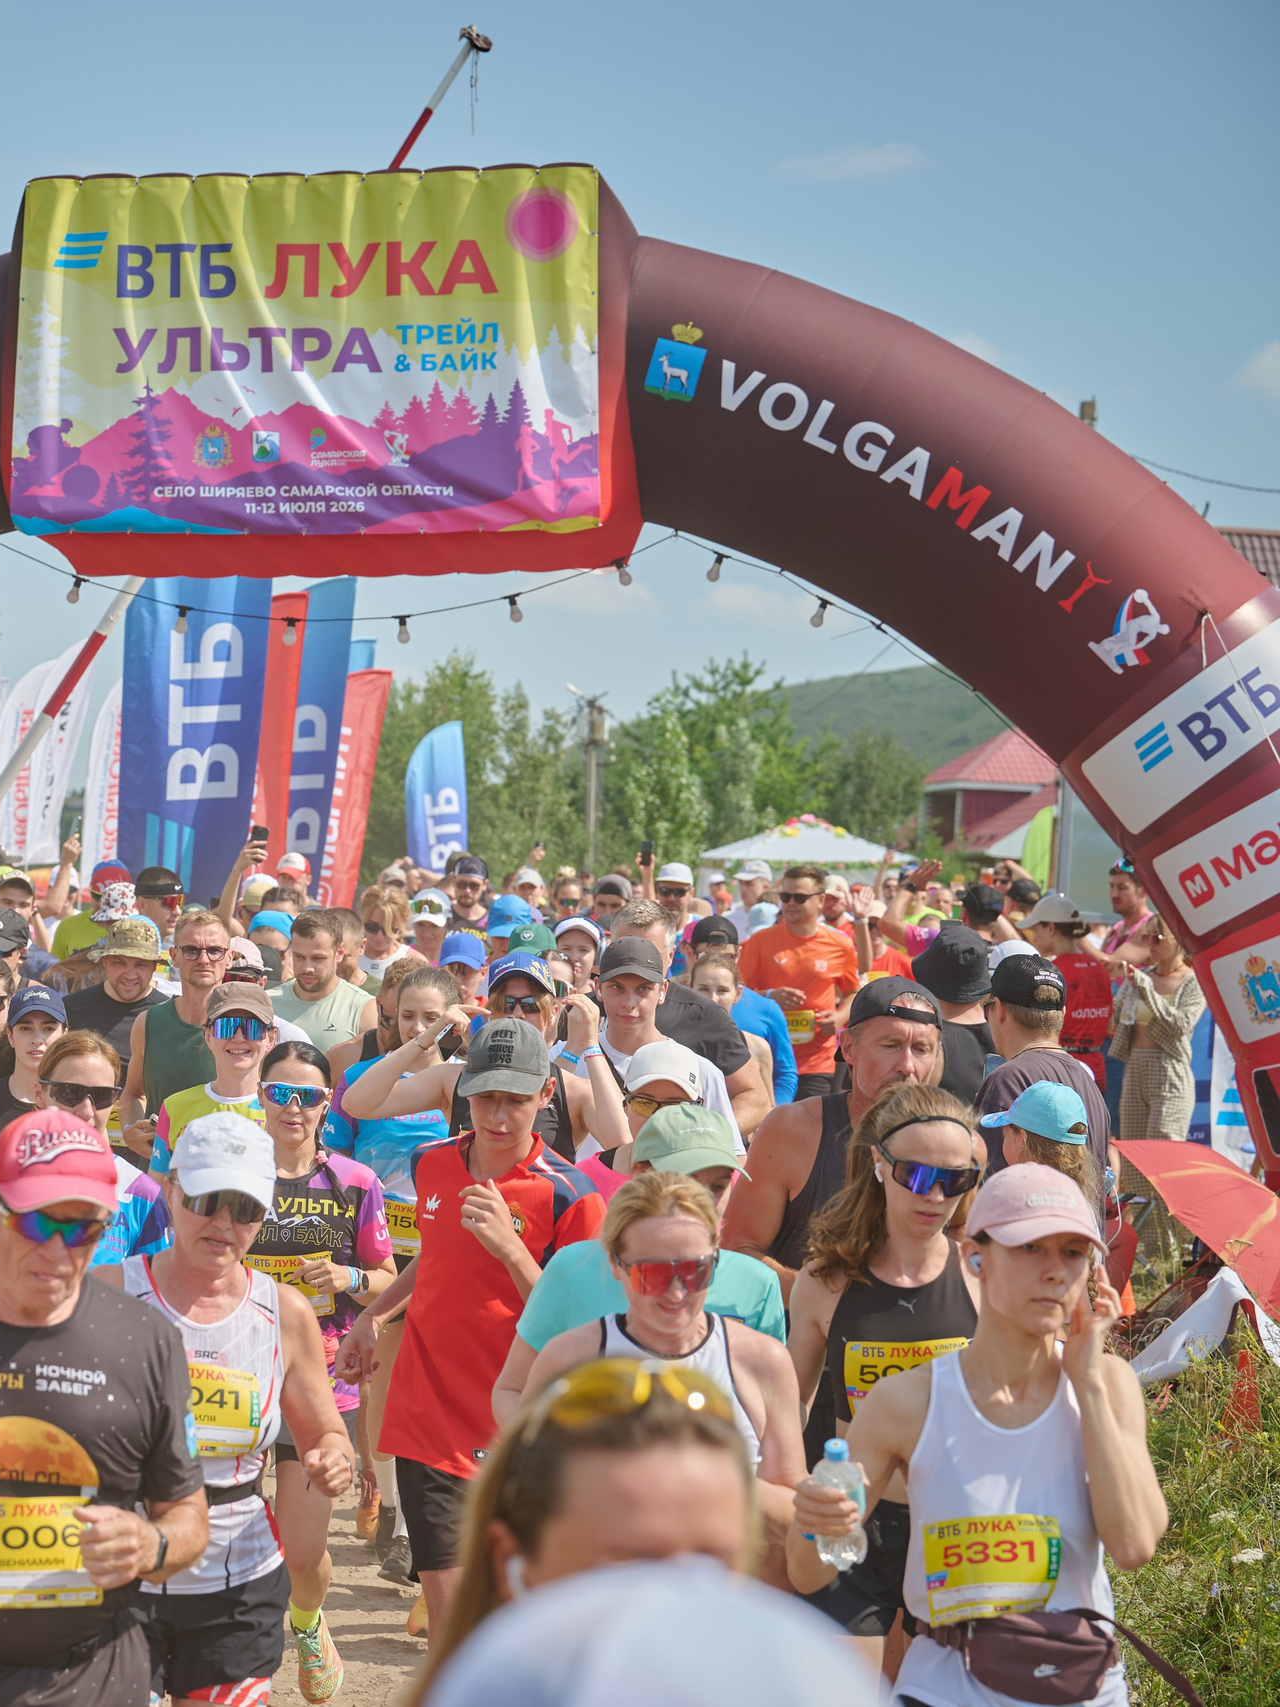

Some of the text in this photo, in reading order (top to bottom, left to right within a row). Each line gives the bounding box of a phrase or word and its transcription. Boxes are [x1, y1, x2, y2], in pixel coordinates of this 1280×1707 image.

[116, 240, 499, 299] ВТБ ЛУКА
[396, 318, 499, 345] ТРЕЙЛ
[113, 327, 384, 374] УЛЬТРА
[394, 346, 499, 372] & БАЙК
[310, 450, 366, 459] САМАРСКАЯ
[310, 459, 337, 467] ЛУКА
[720, 359, 1076, 592] VOLGAMAN
[154, 483, 454, 498] СЕЛО ШИРЯЕВО САМАРСКОЙ ОБЛАСТИ
[244, 501, 365, 514] 11-12 ИЮЛЯ 2026
[166, 622, 244, 801] ВТБ
[1177, 666, 1280, 762] ВТБ
[424, 786, 461, 874] ВТБ
[17, 1128, 101, 1164] Russia
[293, 1224, 343, 1247] БАЙК
[254, 1259, 270, 1267] ВТБ
[194, 1350, 218, 1359] SRC
[862, 1347, 885, 1358] ВТБ
[890, 1346, 933, 1358] ЛУКА
[35, 1364, 107, 1386] НОЧНОЙ
[35, 1379, 93, 1396] ЗАБЕГ
[12, 1503, 59, 1518] ЛУКА
[938, 1524, 961, 1539] ВТБ
[966, 1520, 1015, 1534] ЛУКА
[942, 1540, 1035, 1568] 5331
